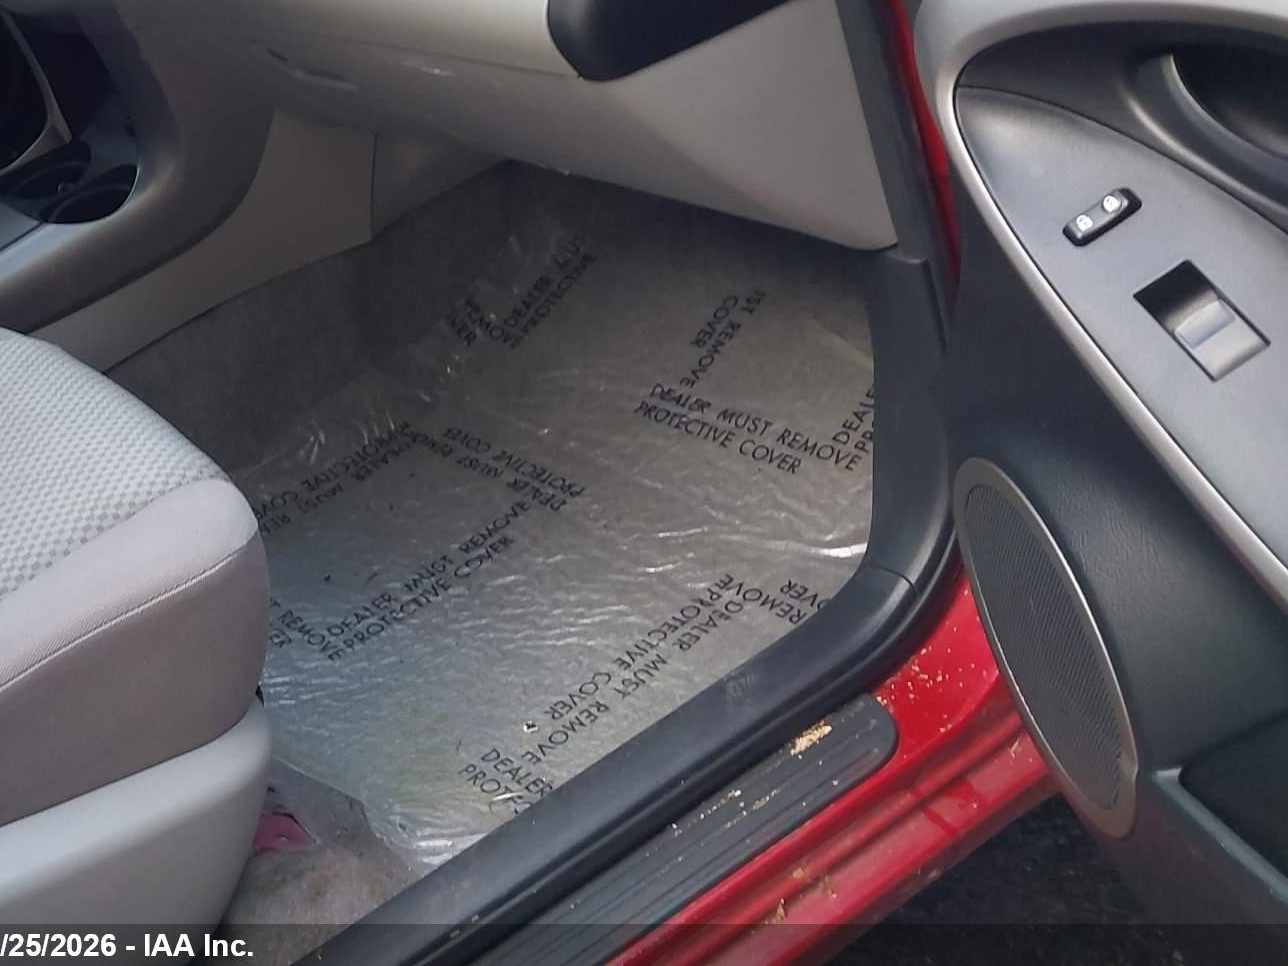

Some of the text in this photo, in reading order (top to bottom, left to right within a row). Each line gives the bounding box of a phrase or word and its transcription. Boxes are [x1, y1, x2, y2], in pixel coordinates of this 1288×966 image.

[680, 320, 742, 388] REMOVE
[690, 295, 738, 348] COVER
[634, 400, 802, 475] PROTECTIVE COVER
[649, 383, 712, 415] DEALER
[716, 408, 774, 436] MUST
[776, 428, 862, 472] REMOVE
[491, 450, 586, 499] PROTECTIVE
[326, 591, 396, 638] DEALER
[458, 501, 532, 554] REMOVE
[344, 536, 515, 651] PROTECTIVE COVER
[717, 573, 808, 625] REMOVE
[279, 609, 345, 661] REMOVE
[543, 587, 723, 720] PROTECTIVE COVER
[521, 600, 744, 765] DEALER MUST REMOVE
